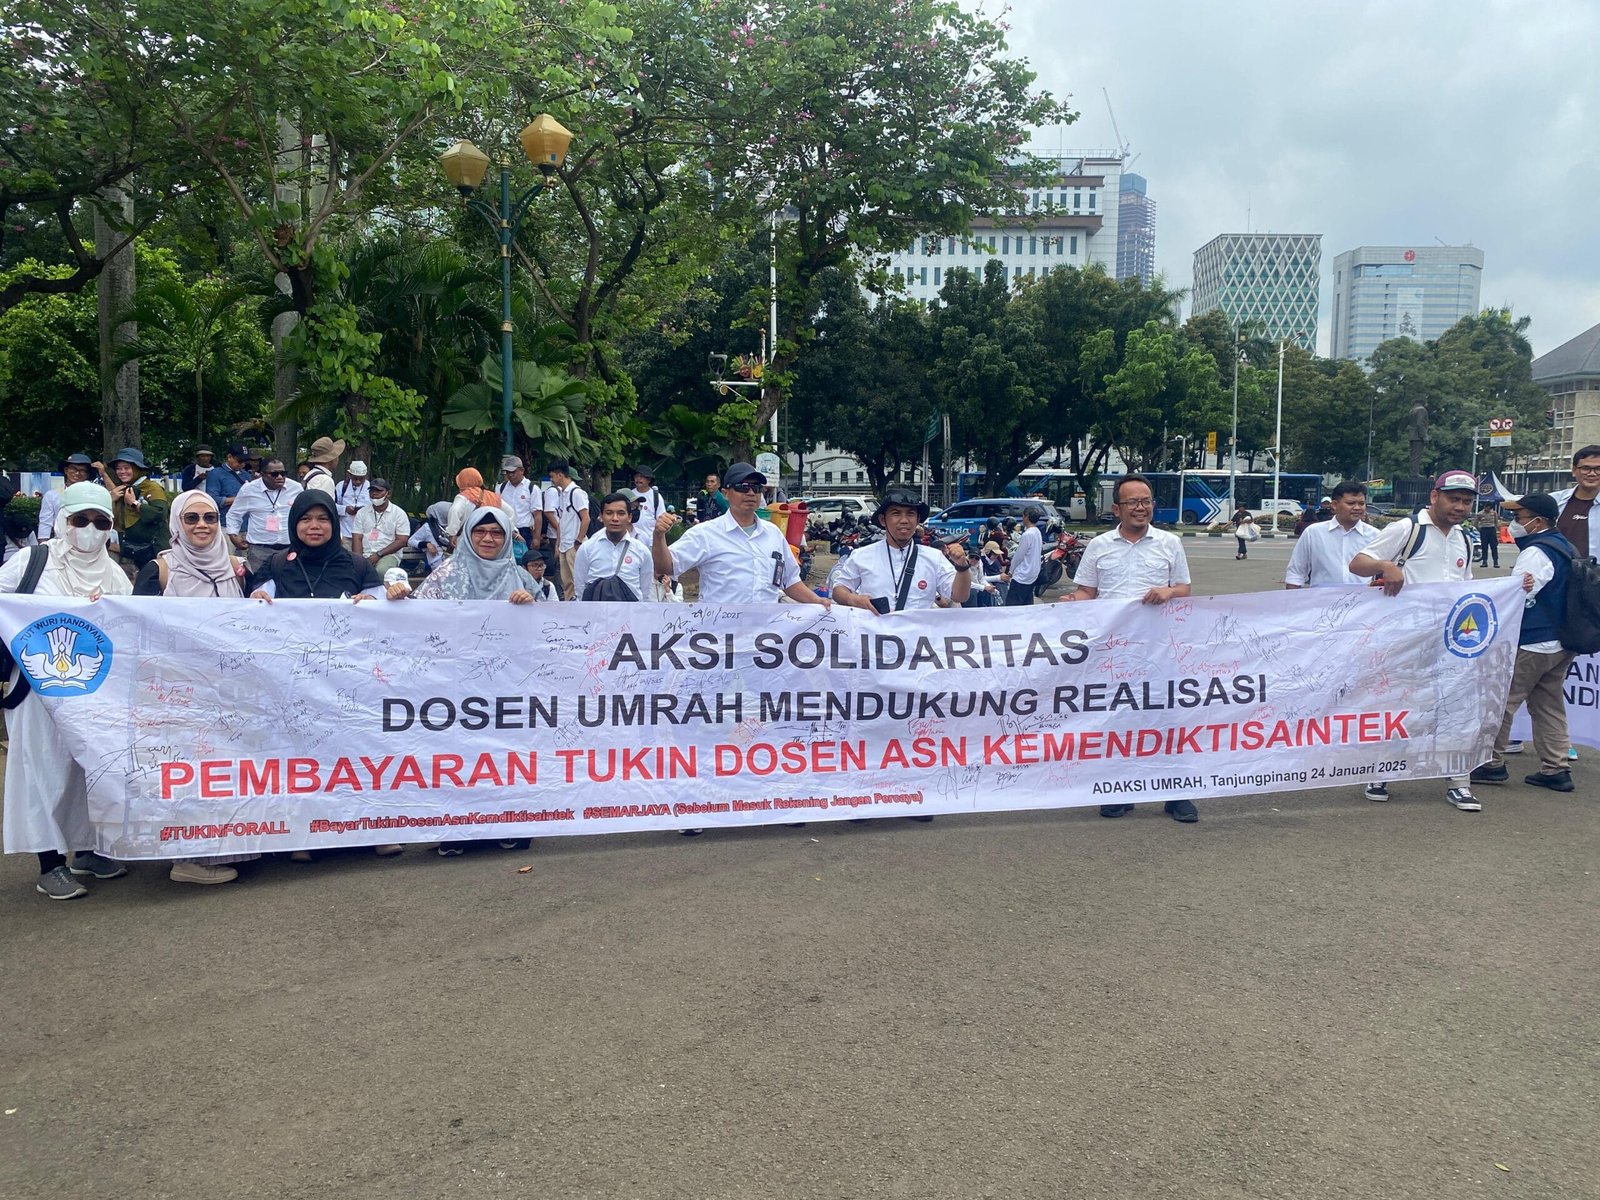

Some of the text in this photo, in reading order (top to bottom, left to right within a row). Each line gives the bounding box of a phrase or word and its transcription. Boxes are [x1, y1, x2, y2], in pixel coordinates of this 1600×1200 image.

[20, 617, 105, 645] TUT WURI HANDAYANI
[608, 632, 735, 671] AKSI
[752, 629, 1090, 671] SOLIDARITAS
[382, 695, 559, 733] DOSEN
[577, 692, 743, 728] UMRAH
[759, 689, 1039, 724] MENDUKUNG
[1052, 673, 1268, 714] REALISASI
[161, 750, 538, 800] PEMBAYARAN
[555, 745, 698, 784] TUKIN
[714, 739, 867, 777] DOSEN
[879, 735, 967, 771] ASN
[983, 710, 1411, 766] KEMENDIKTISAINTEK
[1092, 759, 1408, 795] ADAKSI UMRAH, Tanjungpinang 24 Januari 2025
[160, 790, 925, 841] #TUKINFORALL #BayarTukinDosenAsnKemdiktisaintek #SEMARJAYA (Sebelum Masuk Rekening Jangan Percaya)
